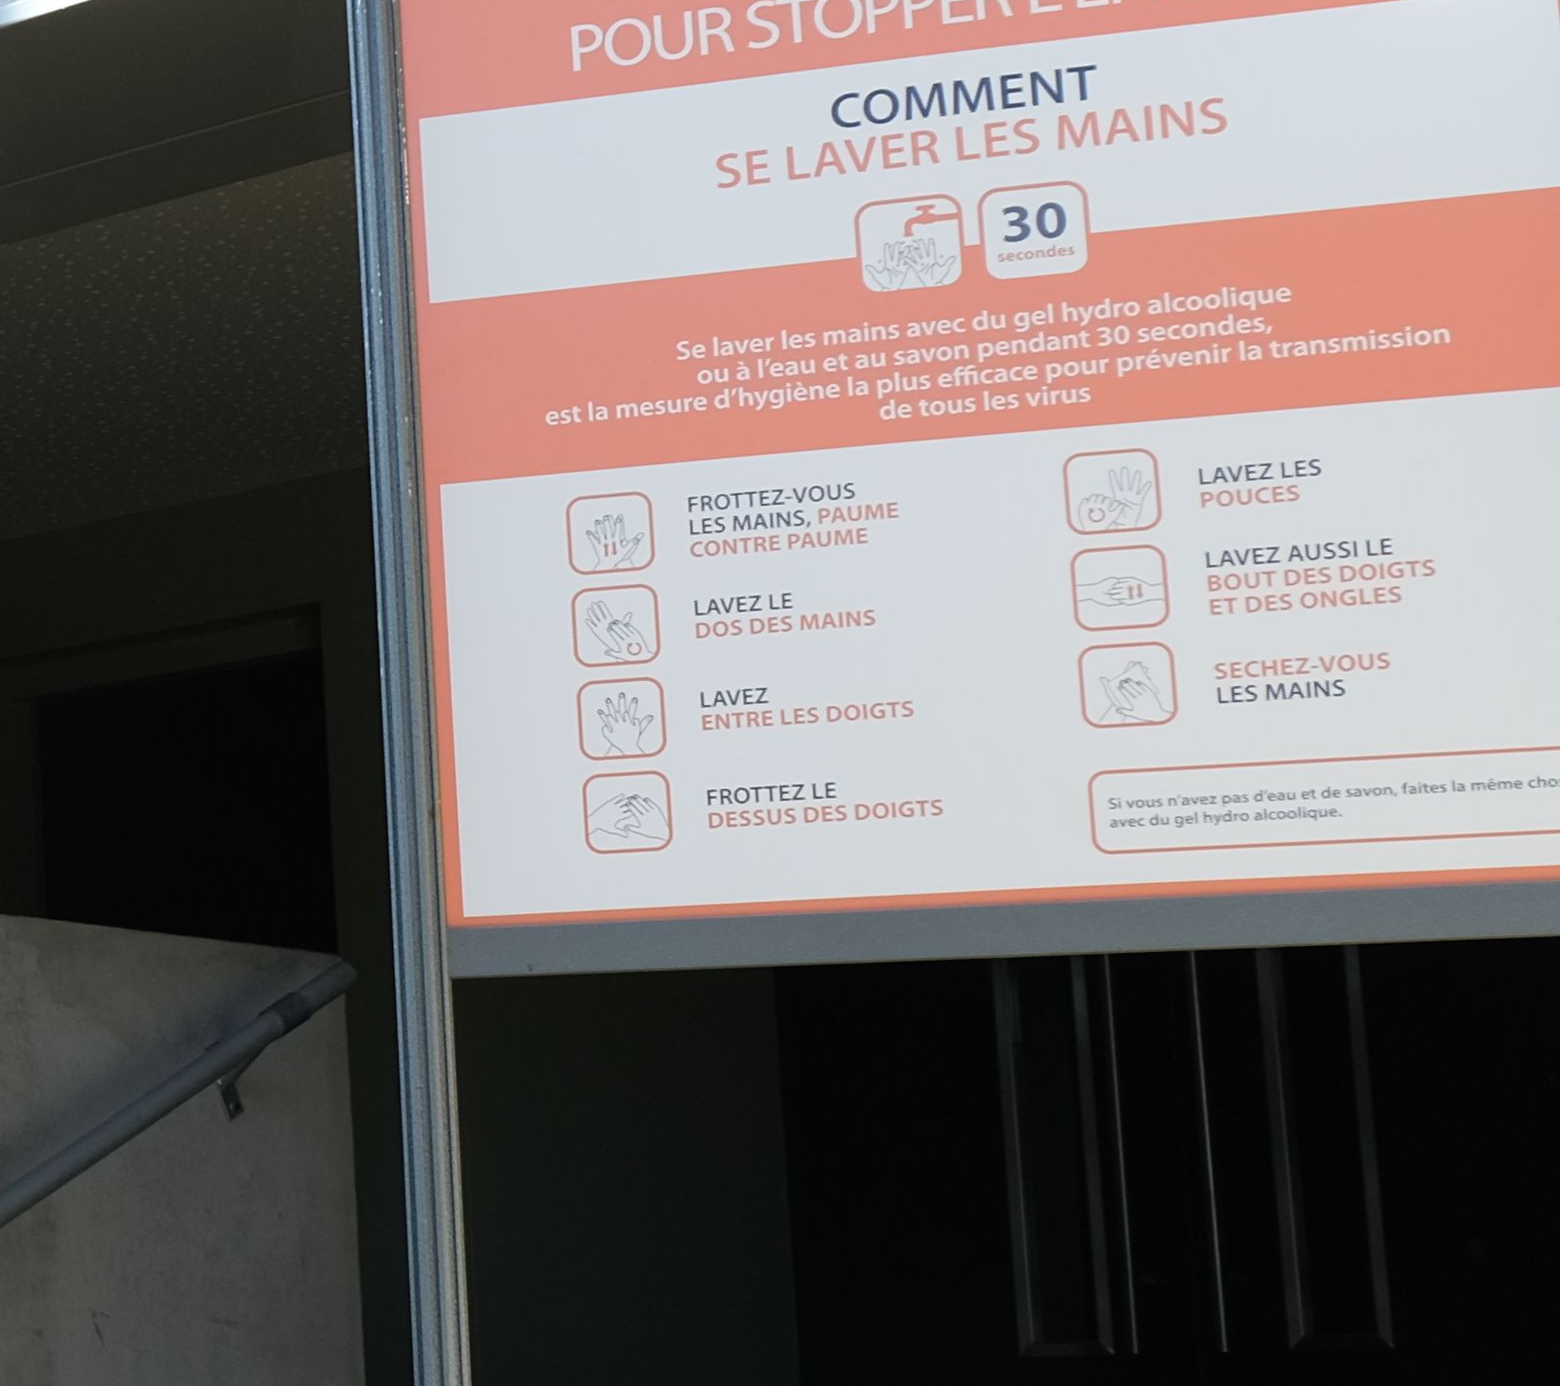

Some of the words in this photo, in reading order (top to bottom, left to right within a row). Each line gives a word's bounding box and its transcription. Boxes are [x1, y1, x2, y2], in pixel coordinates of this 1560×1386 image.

[571, 7, 734, 72] POUR
[831, 64, 1096, 128] COMMENT
[716, 149, 770, 189] SE
[786, 130, 939, 181] LAVER
[955, 118, 1040, 161] LES
[1058, 97, 1227, 150] MAINS
[1002, 202, 1066, 243] 30
[998, 244, 1075, 262] secondes
[677, 340, 705, 360] Se
[713, 336, 774, 357] laver
[781, 329, 816, 350] les
[823, 322, 899, 346] mains
[907, 318, 966, 338] avec
[972, 310, 1006, 331] du
[1014, 303, 1054, 333] gel
[1062, 298, 1140, 327] hydro
[1148, 286, 1291, 315] alcoolique
[697, 367, 729, 385] ou
[736, 361, 750, 381] à
[758, 358, 815, 378] l'eau
[823, 353, 848, 372] et
[855, 352, 886, 369] au
[894, 345, 969, 366] savon
[978, 331, 1091, 363] pendant
[1097, 325, 1130, 347] 30
[1138, 313, 1272, 343] secondes,
[546, 406, 581, 426] est
[588, 401, 608, 422] la
[616, 396, 707, 419] mesure
[714, 381, 840, 411] d'hygiène
[848, 376, 869, 396] la
[877, 372, 931, 400] plus
[938, 365, 1037, 388] efficace
[1046, 358, 1109, 384] pour
[1117, 344, 1232, 377] prévenir
[1239, 341, 1262, 361] la
[1269, 328, 1450, 358] transmission
[880, 398, 912, 420] de
[919, 397, 976, 417] tous
[983, 390, 1019, 411] les
[1026, 385, 1091, 407] virus
[1199, 463, 1273, 485] LAVEZ
[1281, 458, 1321, 479] LES
[688, 482, 855, 513] FROTTEZ-VOUS
[1200, 485, 1300, 508] POUCES
[689, 516, 725, 535] LES
[733, 509, 811, 532] MAINS,
[819, 502, 898, 523] PAUME
[690, 535, 781, 558] CONTRE
[788, 527, 868, 550] PAUME
[1206, 546, 1280, 568] LAVEZ
[1288, 540, 1358, 562] AUSSI
[1366, 538, 1393, 556] LE
[1208, 570, 1276, 592] BOUT
[1284, 566, 1332, 587] DES
[1339, 559, 1435, 583] DOIGTS
[694, 595, 762, 616] LAVEZ
[769, 592, 792, 611] LE
[1209, 596, 1237, 616] ET
[1245, 593, 1292, 613] DES
[1300, 585, 1402, 609] ONGLES
[696, 619, 743, 639] DOS
[750, 615, 792, 635] DES
[800, 609, 875, 630] MAINS
[1215, 651, 1390, 680] SECHEZ-VOUS
[701, 687, 769, 708] LAVEZ
[1217, 684, 1257, 704] LES
[1266, 679, 1345, 701] MAINS
[702, 709, 773, 731] ENTRE
[780, 706, 819, 726] LES
[826, 700, 914, 723] DOIGTS
[707, 784, 805, 806] FROTTEZ
[812, 782, 836, 800] LE
[1108, 797, 1121, 810] Si
[1126, 798, 1163, 809] vous
[1222, 793, 1249, 805] pas
[1301, 789, 1316, 800] et
[1321, 786, 1341, 799] de
[1346, 786, 1397, 798] savon,
[1401, 781, 1447, 795] faites
[1452, 780, 1466, 793] la
[1471, 778, 1523, 791] même
[1527, 776, 1560, 789] cho
[708, 807, 796, 829] DESSUS
[804, 805, 847, 824] DES
[855, 799, 943, 821] DOIGTS
[1110, 817, 1145, 829] avec
[1149, 813, 1169, 827] du
[1174, 811, 1198, 828] gel
[1203, 810, 1249, 826] hydro
[1254, 806, 1342, 822] alcoolique.
